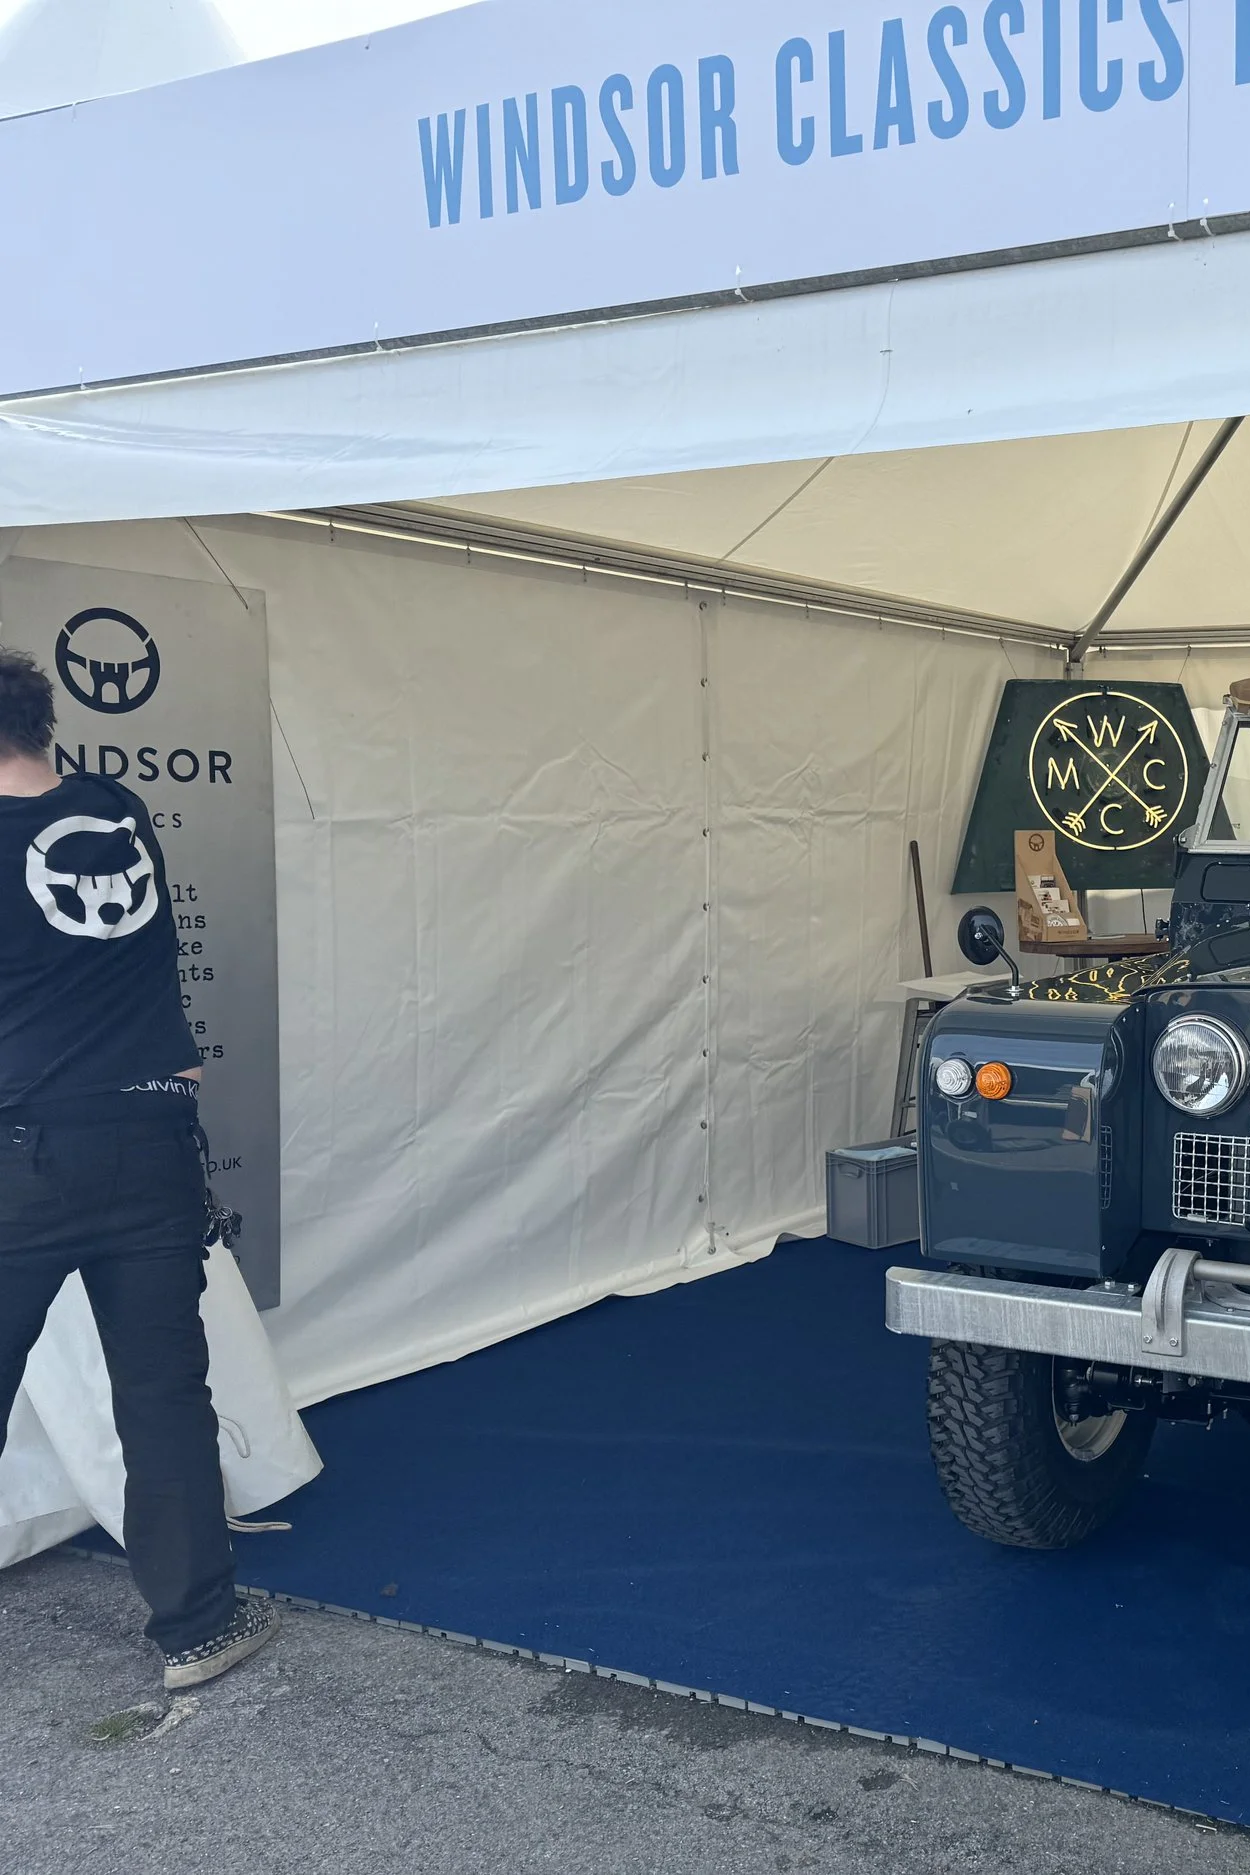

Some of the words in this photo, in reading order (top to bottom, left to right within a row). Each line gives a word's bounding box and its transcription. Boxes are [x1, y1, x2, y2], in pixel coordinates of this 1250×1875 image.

[417, 53, 740, 229] WINDSOR
[774, 0, 1185, 166] CLASSICS
[1086, 714, 1126, 748] W
[54, 742, 233, 784] NDSOR
[1047, 757, 1080, 790] M
[1143, 759, 1166, 790] C
[1100, 803, 1124, 835] C
